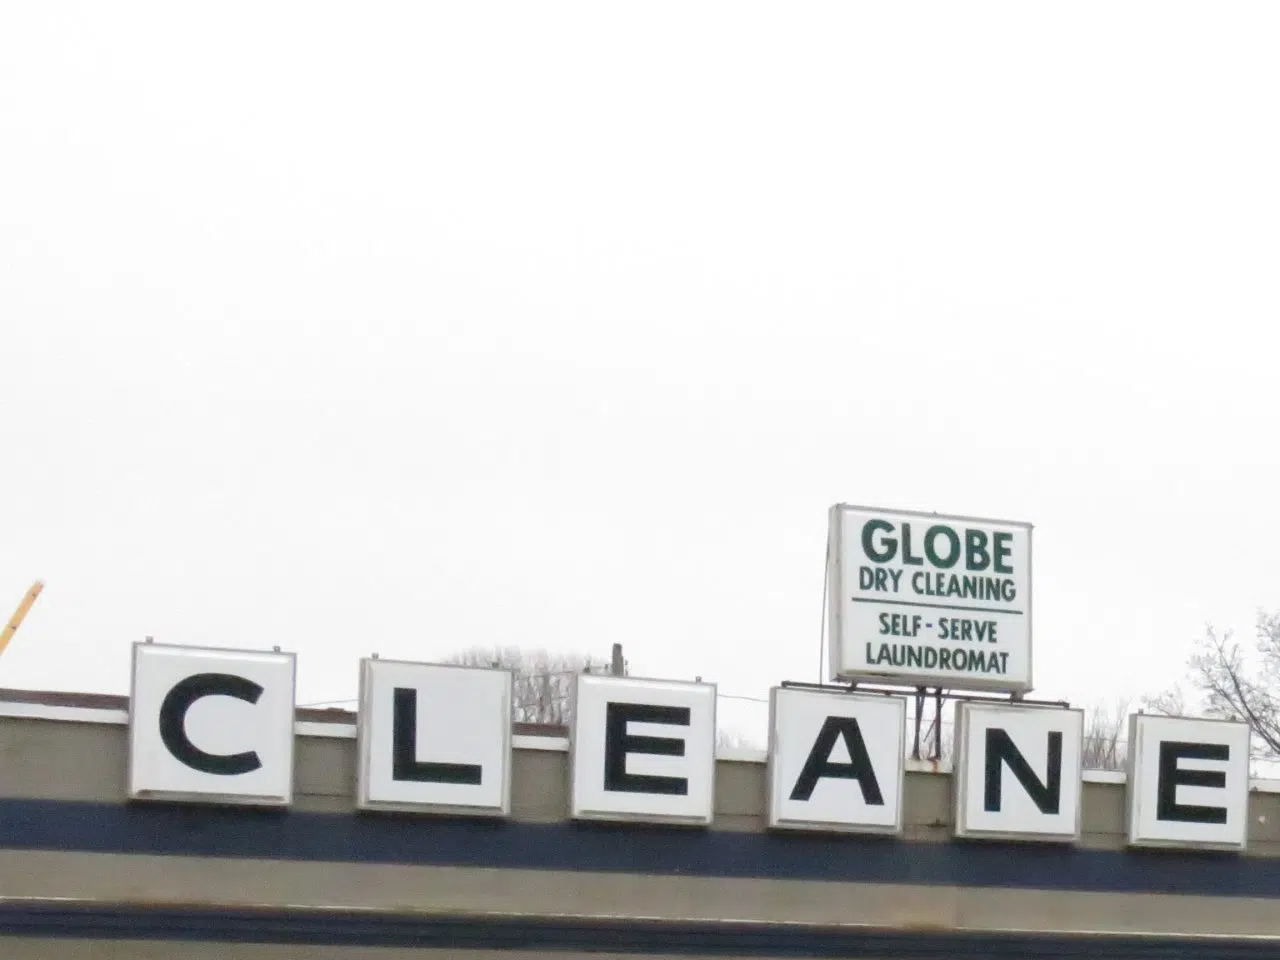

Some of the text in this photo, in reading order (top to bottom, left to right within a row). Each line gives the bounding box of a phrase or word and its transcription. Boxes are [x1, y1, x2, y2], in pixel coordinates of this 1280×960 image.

[861, 519, 1014, 575] GLOBE
[859, 566, 1016, 602] DRY CLEANING
[866, 642, 1009, 674] LAUNDROMAT
